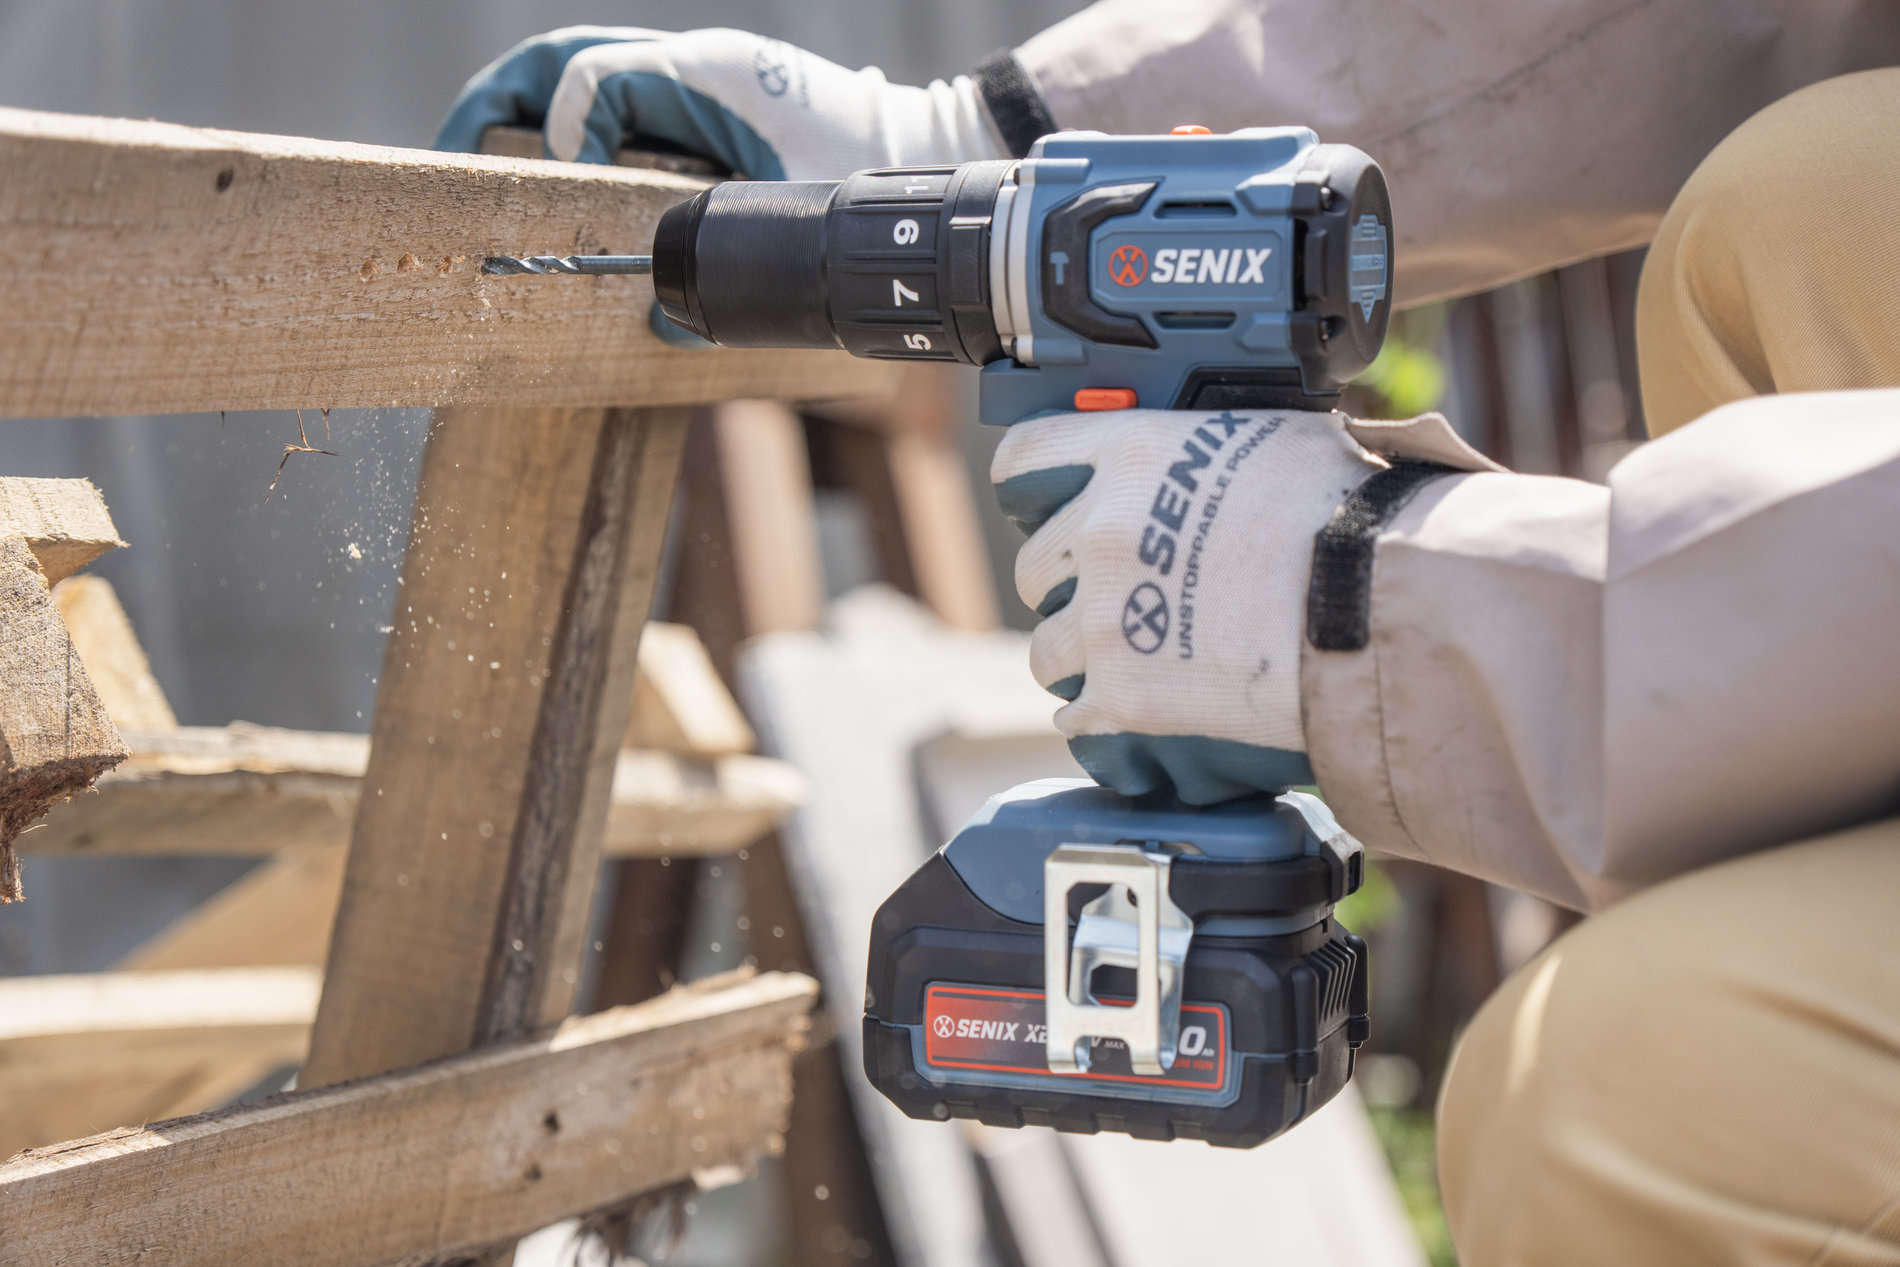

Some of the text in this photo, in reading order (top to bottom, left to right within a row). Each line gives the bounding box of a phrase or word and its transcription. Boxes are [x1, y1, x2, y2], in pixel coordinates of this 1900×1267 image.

[893, 218, 920, 245] 9
[1150, 248, 1272, 284] SENIX
[892, 279, 919, 307] 7
[903, 333, 932, 350] 5
[1139, 410, 1251, 575] SENIX
[1179, 475, 1230, 659] UNSTOPPABLE
[955, 1019, 1019, 1042] SENIX
